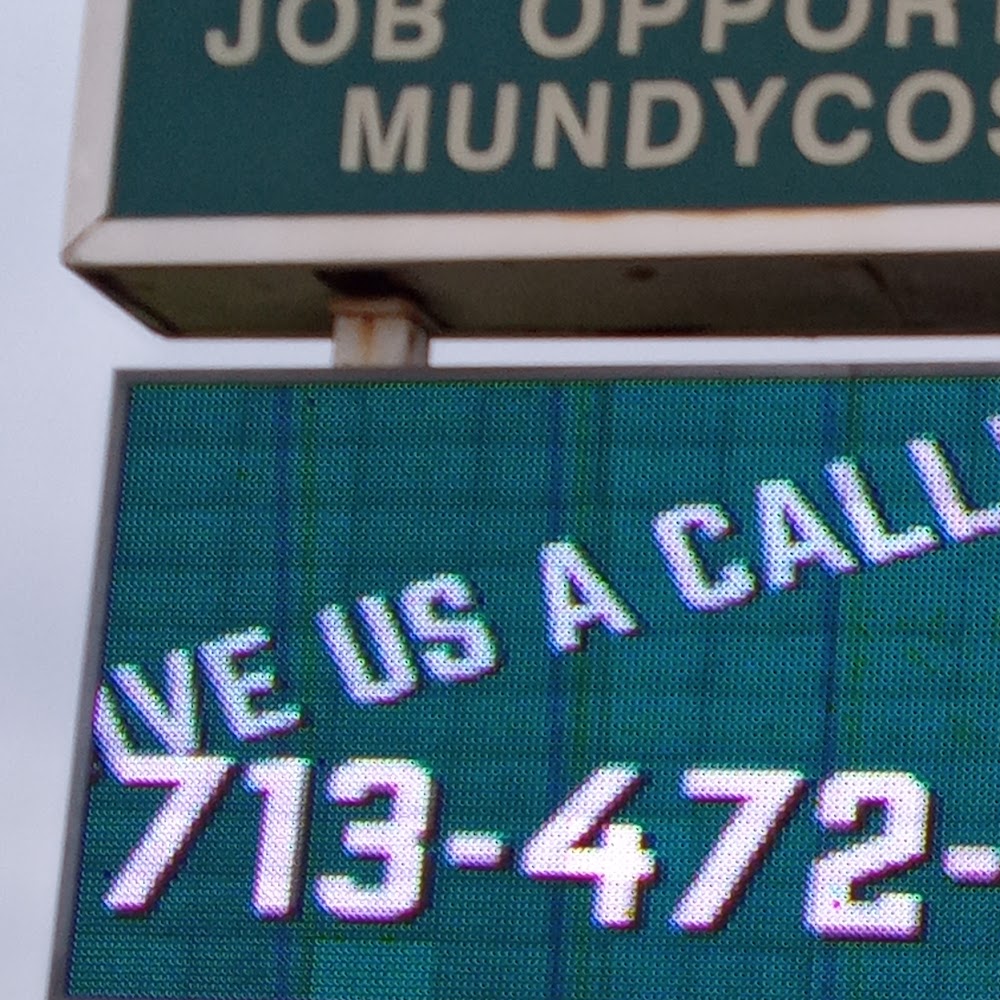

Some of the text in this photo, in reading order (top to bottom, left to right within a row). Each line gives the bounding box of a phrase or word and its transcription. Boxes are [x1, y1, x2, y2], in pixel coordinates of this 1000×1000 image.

[205, 0, 443, 66] JOB
[316, 574, 498, 706] US
[541, 541, 638, 653] A
